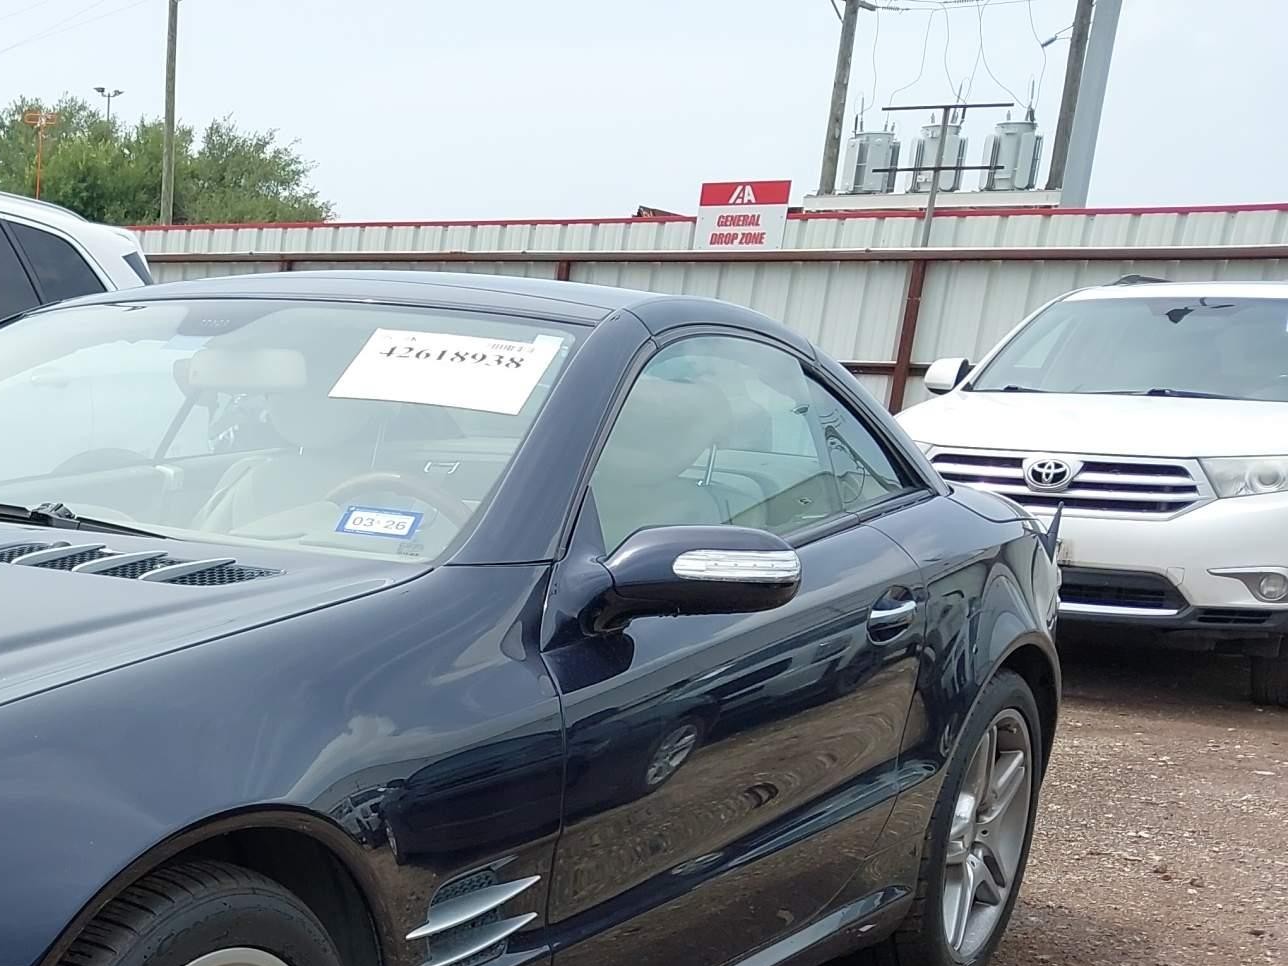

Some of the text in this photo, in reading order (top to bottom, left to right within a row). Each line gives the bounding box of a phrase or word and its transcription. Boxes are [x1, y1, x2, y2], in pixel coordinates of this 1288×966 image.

[717, 214, 761, 227] GENERAL
[710, 232, 766, 245] DROP ZONE
[379, 346, 524, 368] 42618938
[352, 516, 408, 530] 03 26
